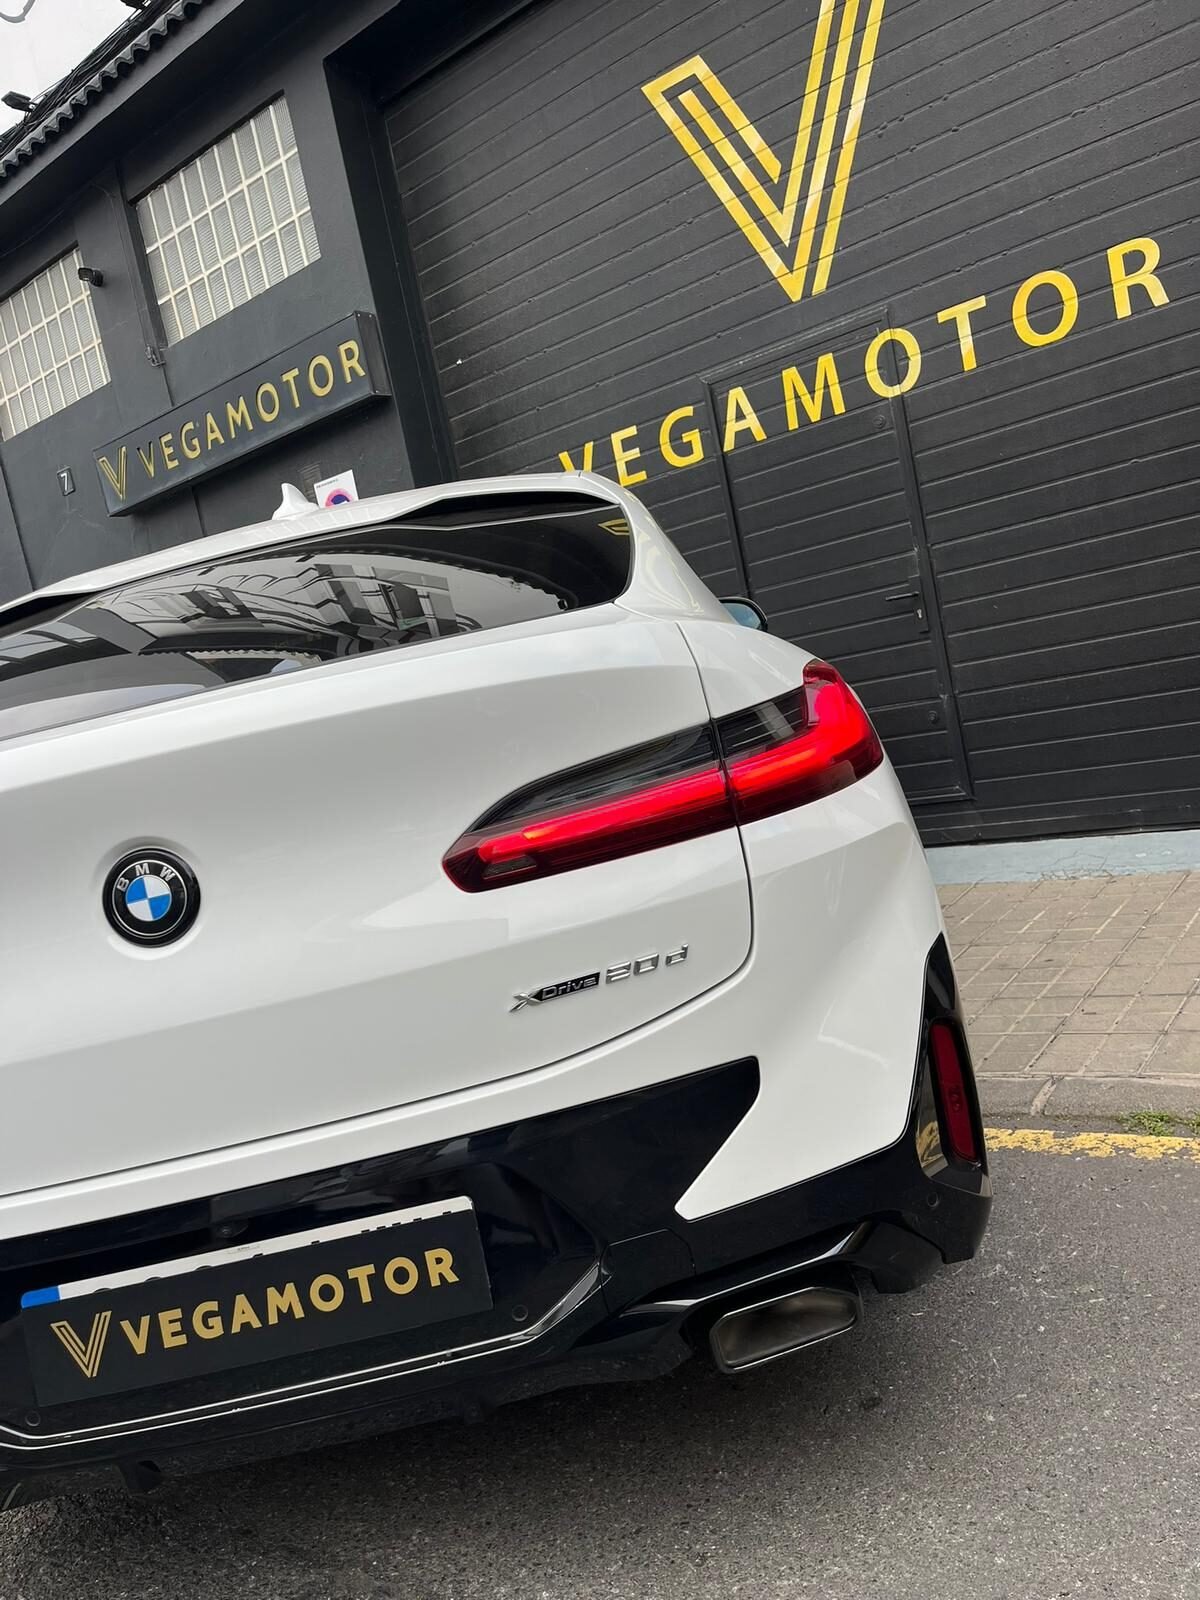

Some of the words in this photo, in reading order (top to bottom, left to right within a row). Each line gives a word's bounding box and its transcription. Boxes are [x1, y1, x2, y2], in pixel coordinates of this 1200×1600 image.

[136, 339, 366, 478] VEGAMOTOR
[117, 862, 176, 892] BMW
[120, 1247, 460, 1356] VEGAMOTOR
